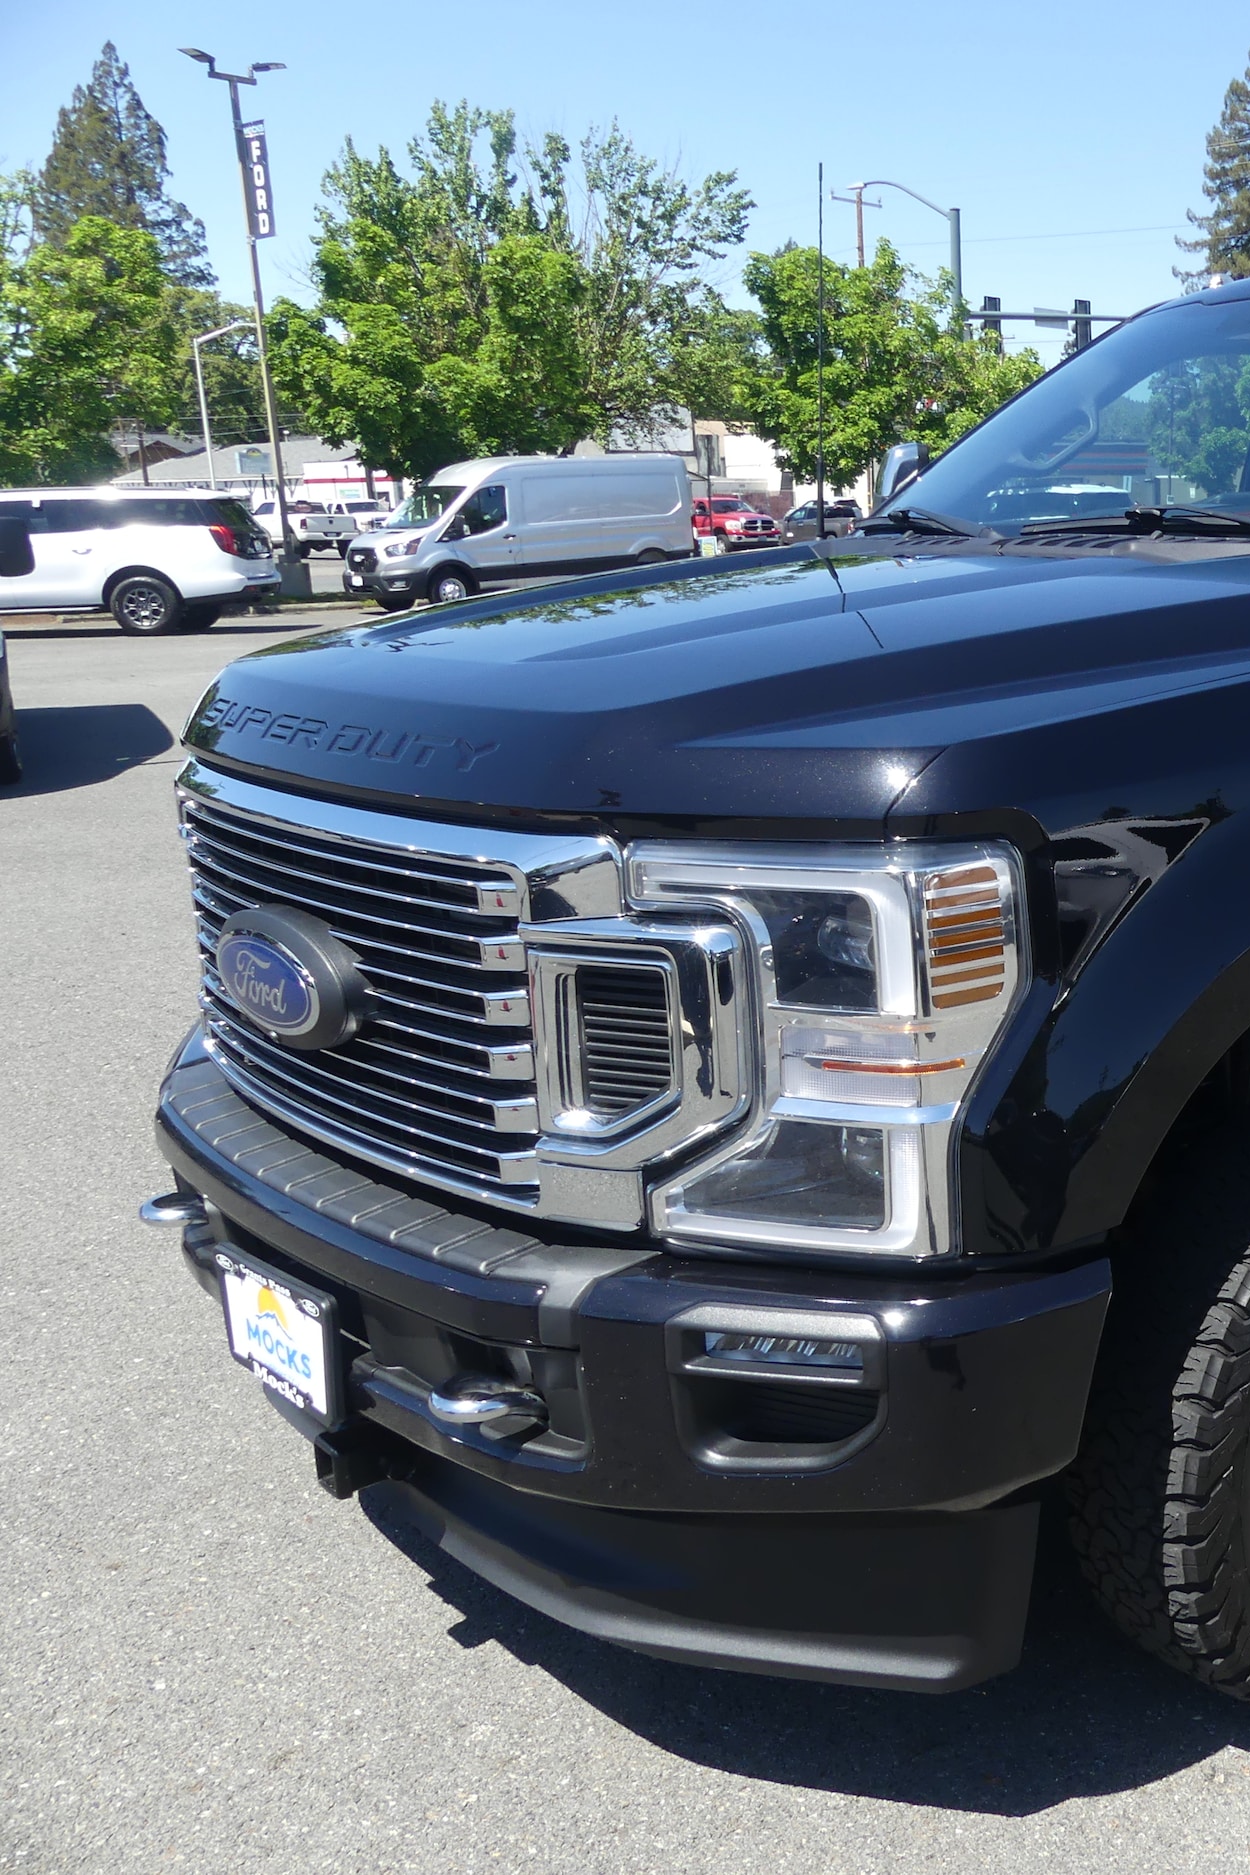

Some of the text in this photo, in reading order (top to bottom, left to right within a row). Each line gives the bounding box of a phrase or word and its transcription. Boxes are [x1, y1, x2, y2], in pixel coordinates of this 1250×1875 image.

[250, 140, 269, 234] FORD
[201, 697, 500, 773] SUPER DUTY
[234, 950, 287, 1014] Ford
[246, 1318, 312, 1379] MOCKS
